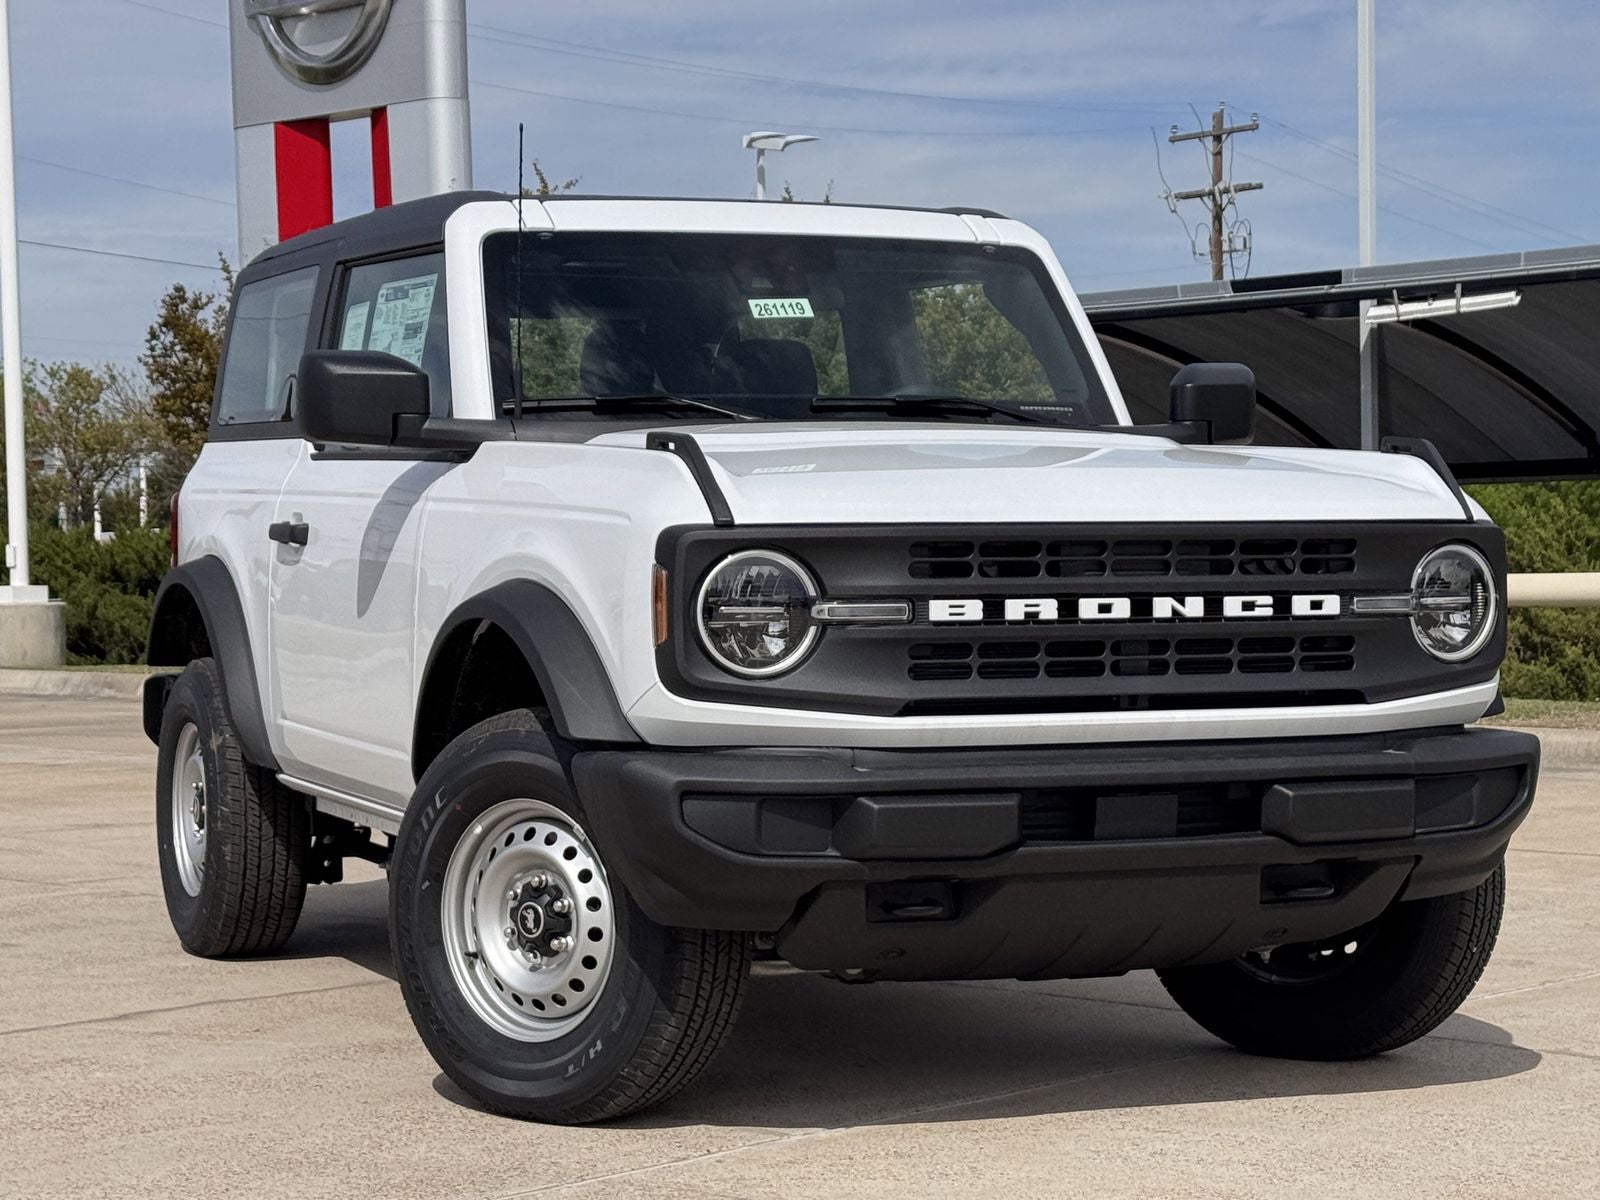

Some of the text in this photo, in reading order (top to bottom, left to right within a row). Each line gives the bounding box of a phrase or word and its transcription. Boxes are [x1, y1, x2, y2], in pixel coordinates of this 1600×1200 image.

[755, 302, 805, 316] 261119
[928, 594, 1341, 622] BRONCO
[565, 1039, 603, 1078] H/T
